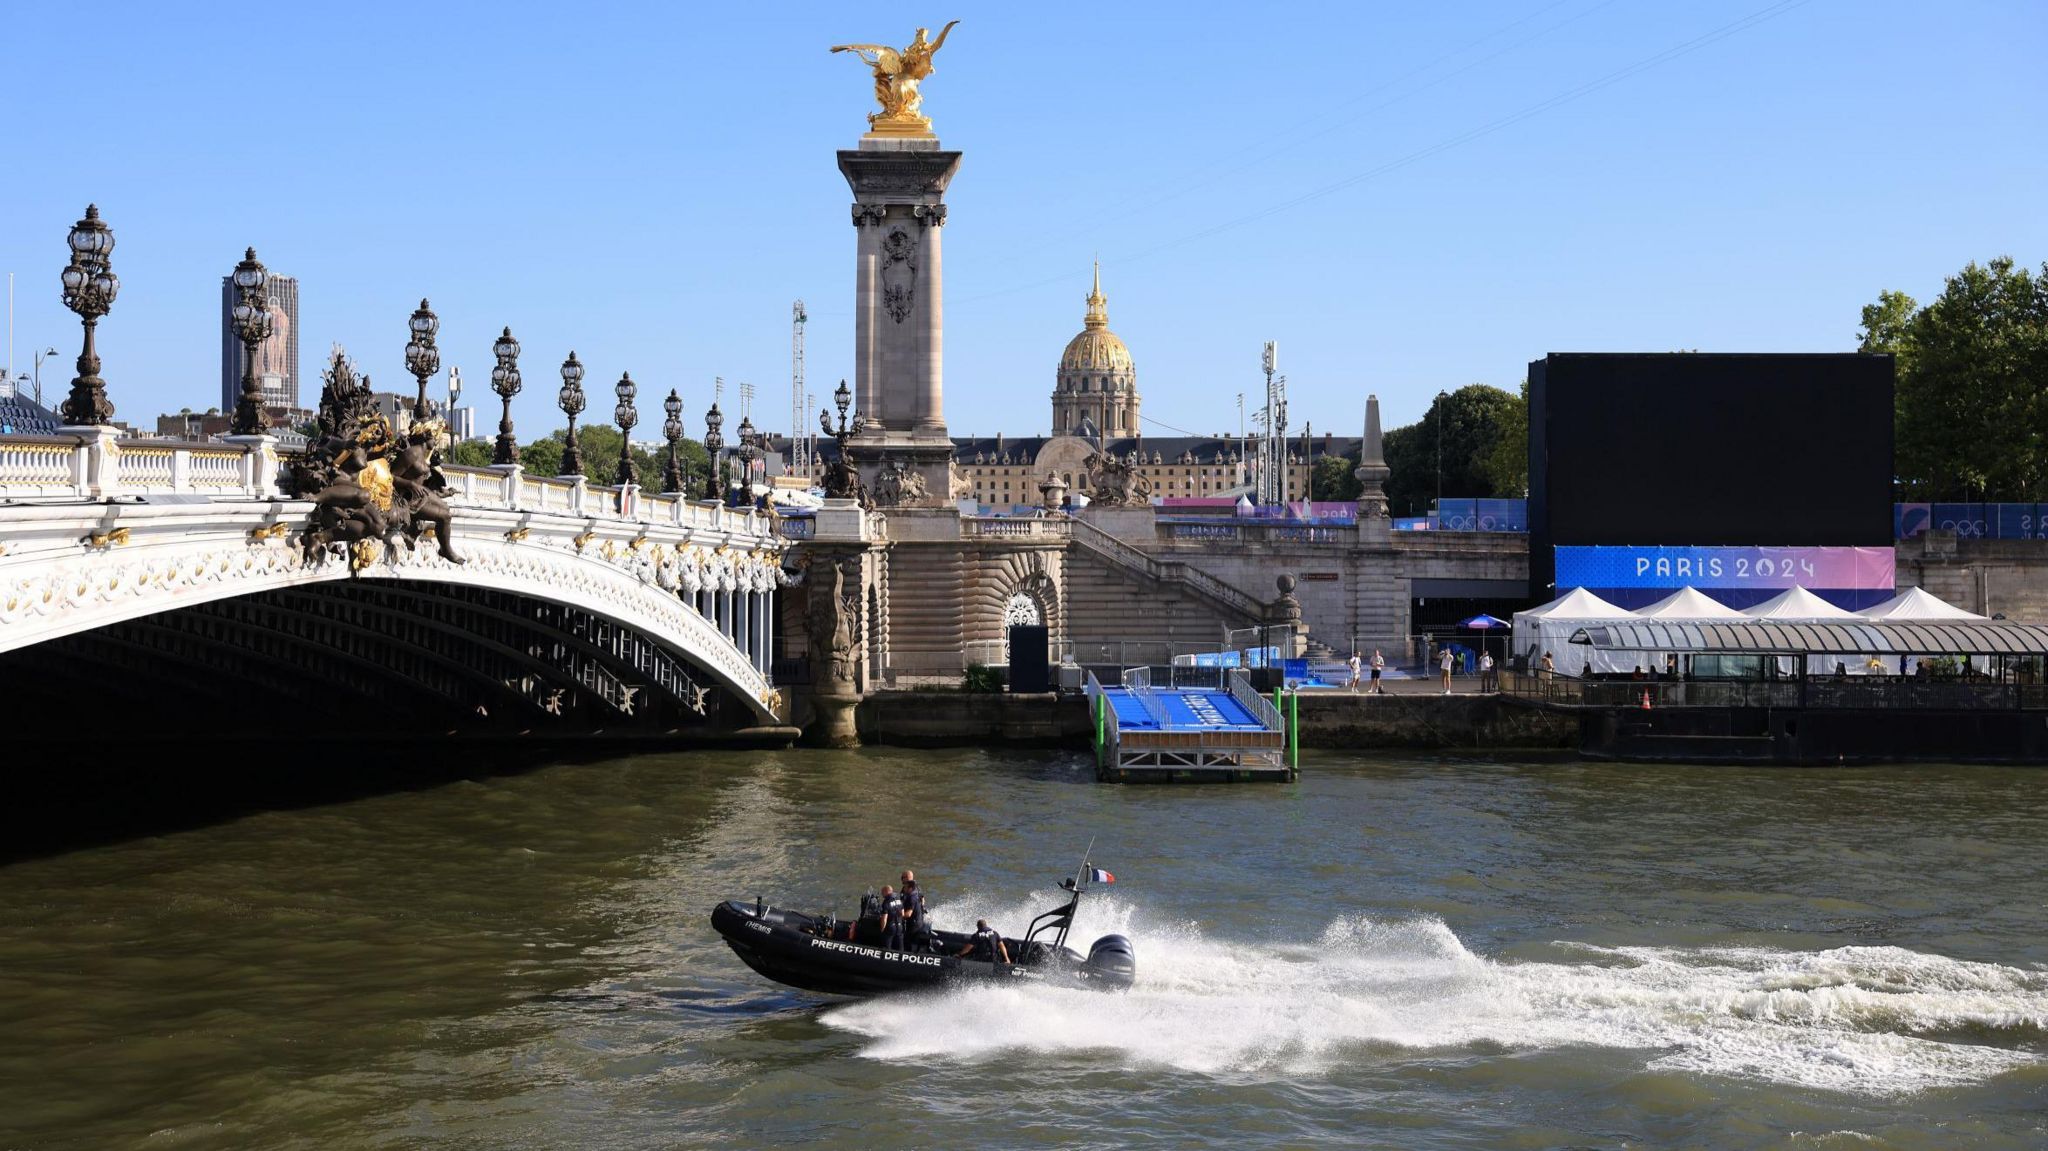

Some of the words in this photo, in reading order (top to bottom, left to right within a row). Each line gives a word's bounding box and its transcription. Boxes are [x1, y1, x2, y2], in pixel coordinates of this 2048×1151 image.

[1736, 558, 1814, 578] 2024
[745, 920, 773, 935] THEMIS
[811, 939, 882, 959] PREFECTURE
[884, 951, 899, 962] DE
[902, 954, 941, 966] POLICE
